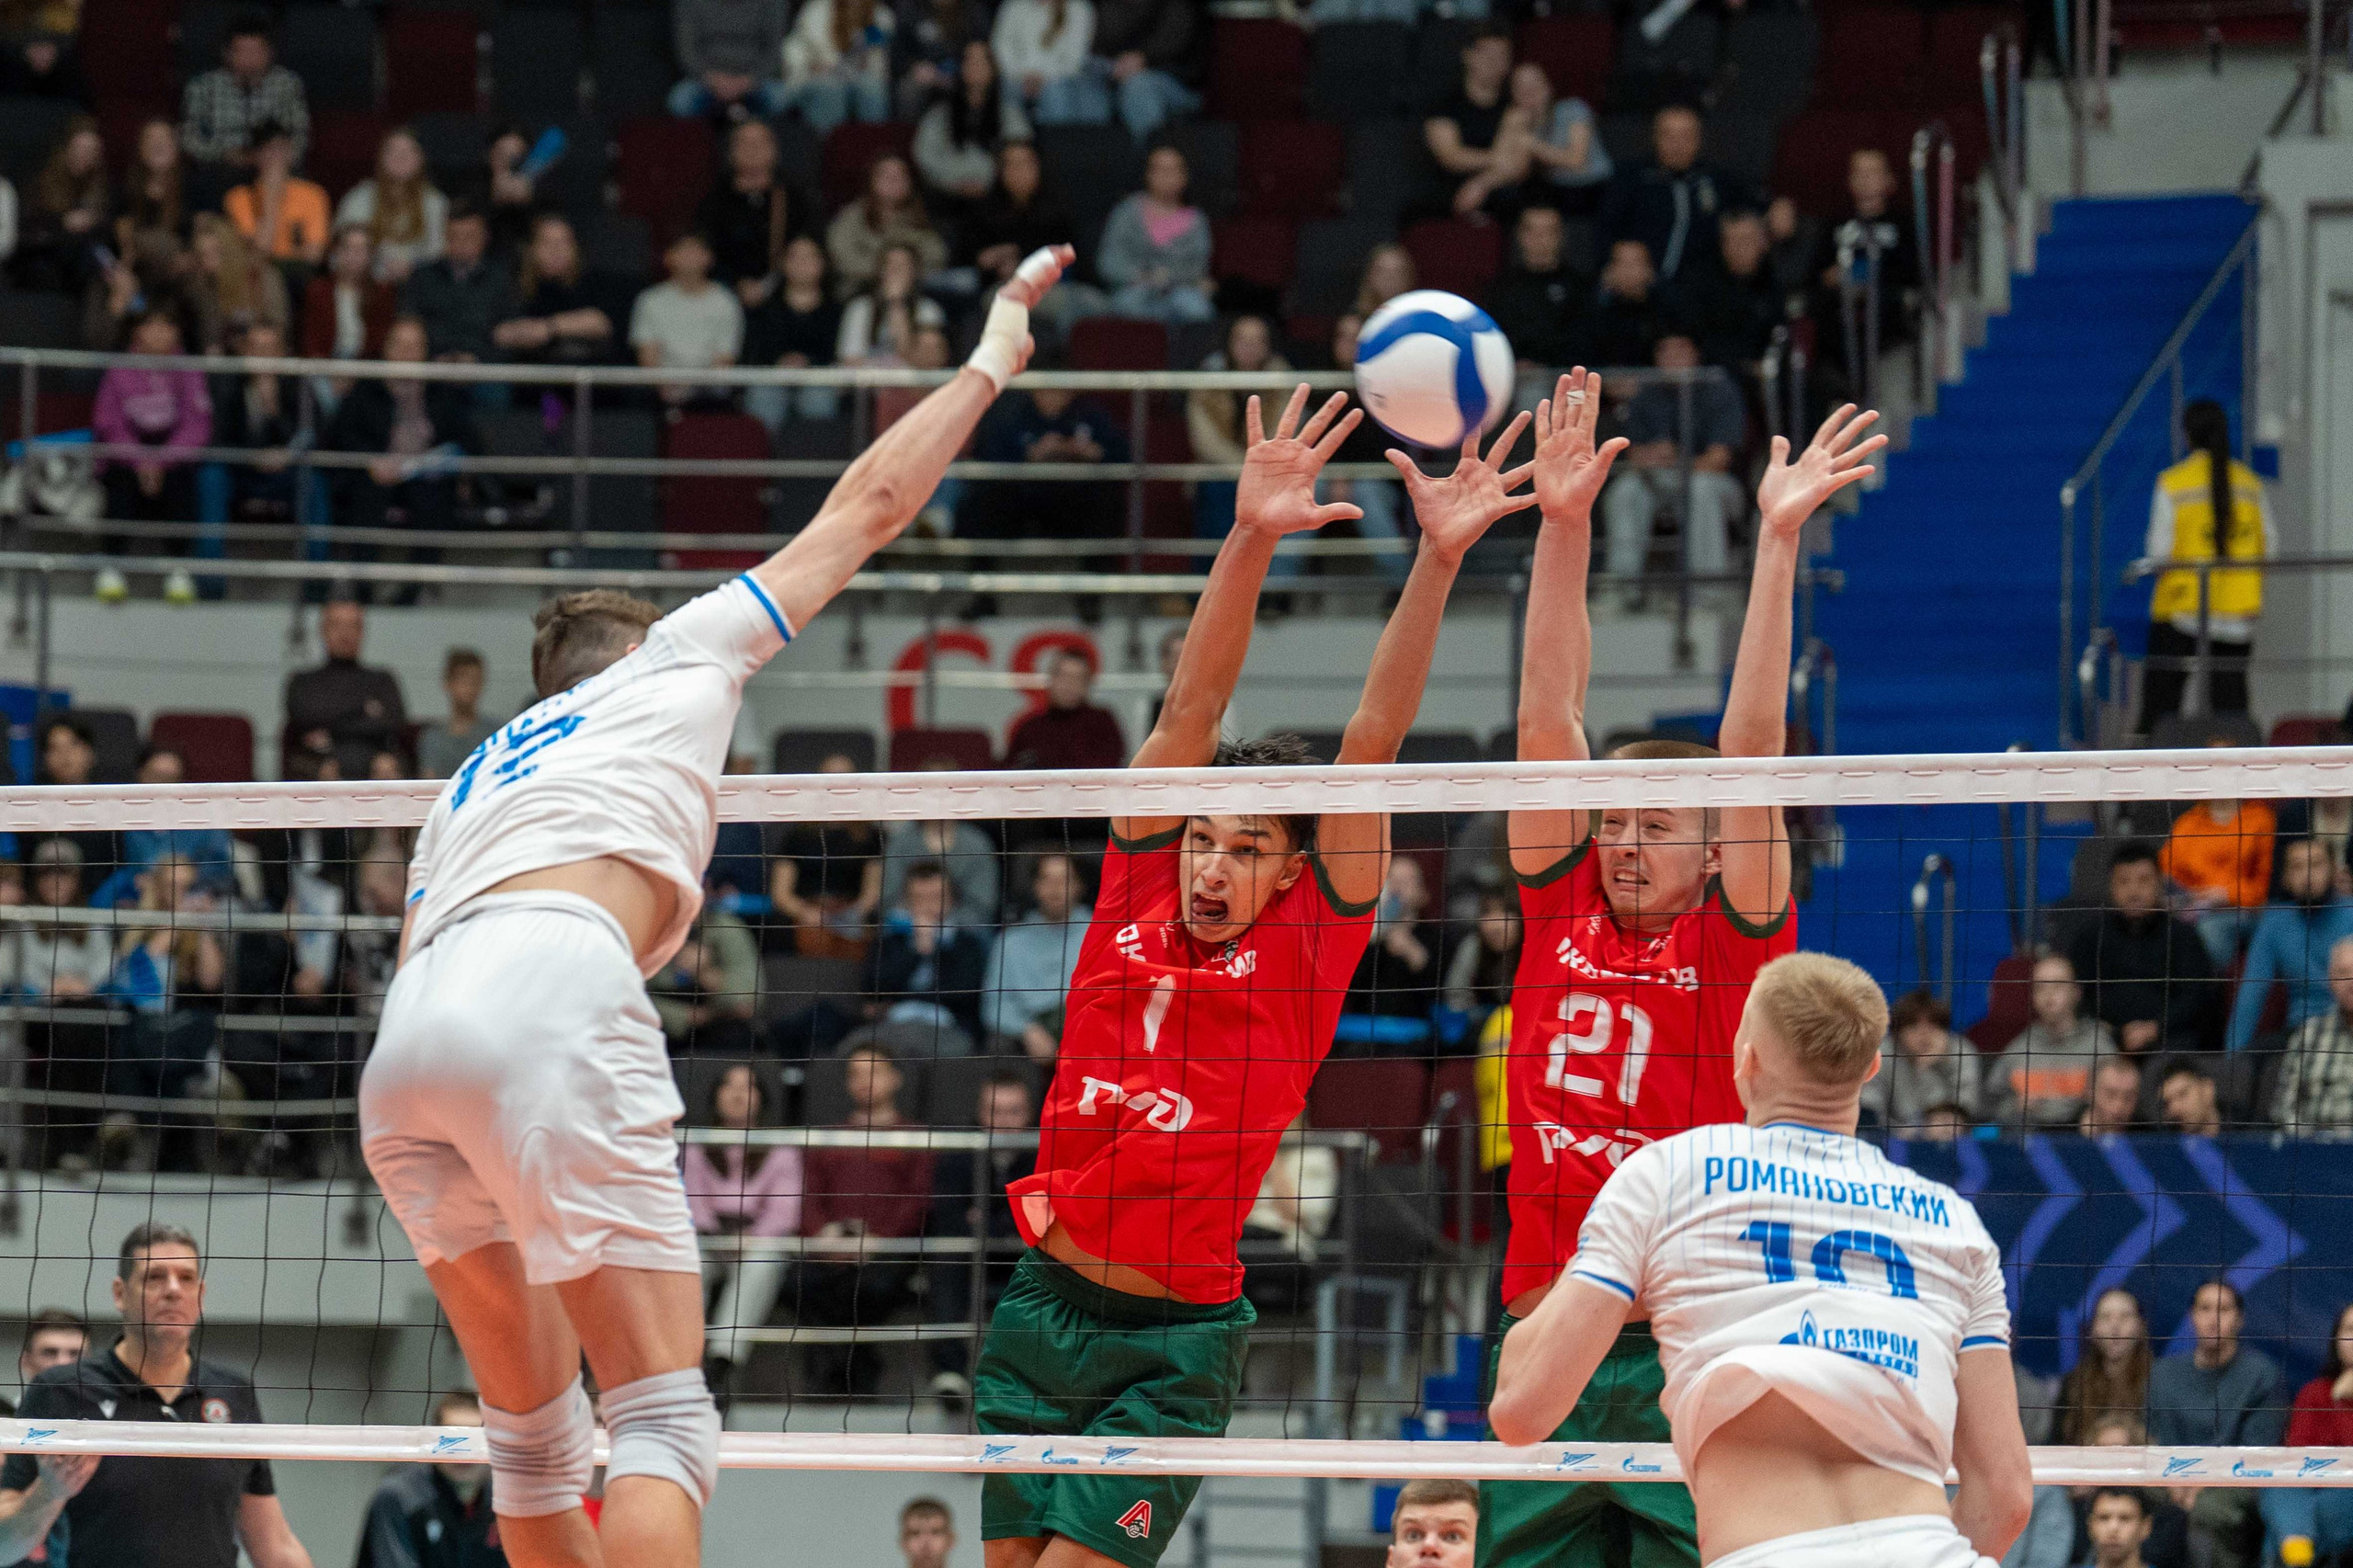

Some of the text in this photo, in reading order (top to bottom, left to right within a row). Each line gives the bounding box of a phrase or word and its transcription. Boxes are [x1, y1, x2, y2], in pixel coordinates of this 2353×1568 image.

[1142, 974, 1176, 1054] 1
[1545, 992, 1654, 1107] 21
[1738, 1221, 1918, 1300] 10
[1824, 1328, 1918, 1361] ГАЗПРОМ
